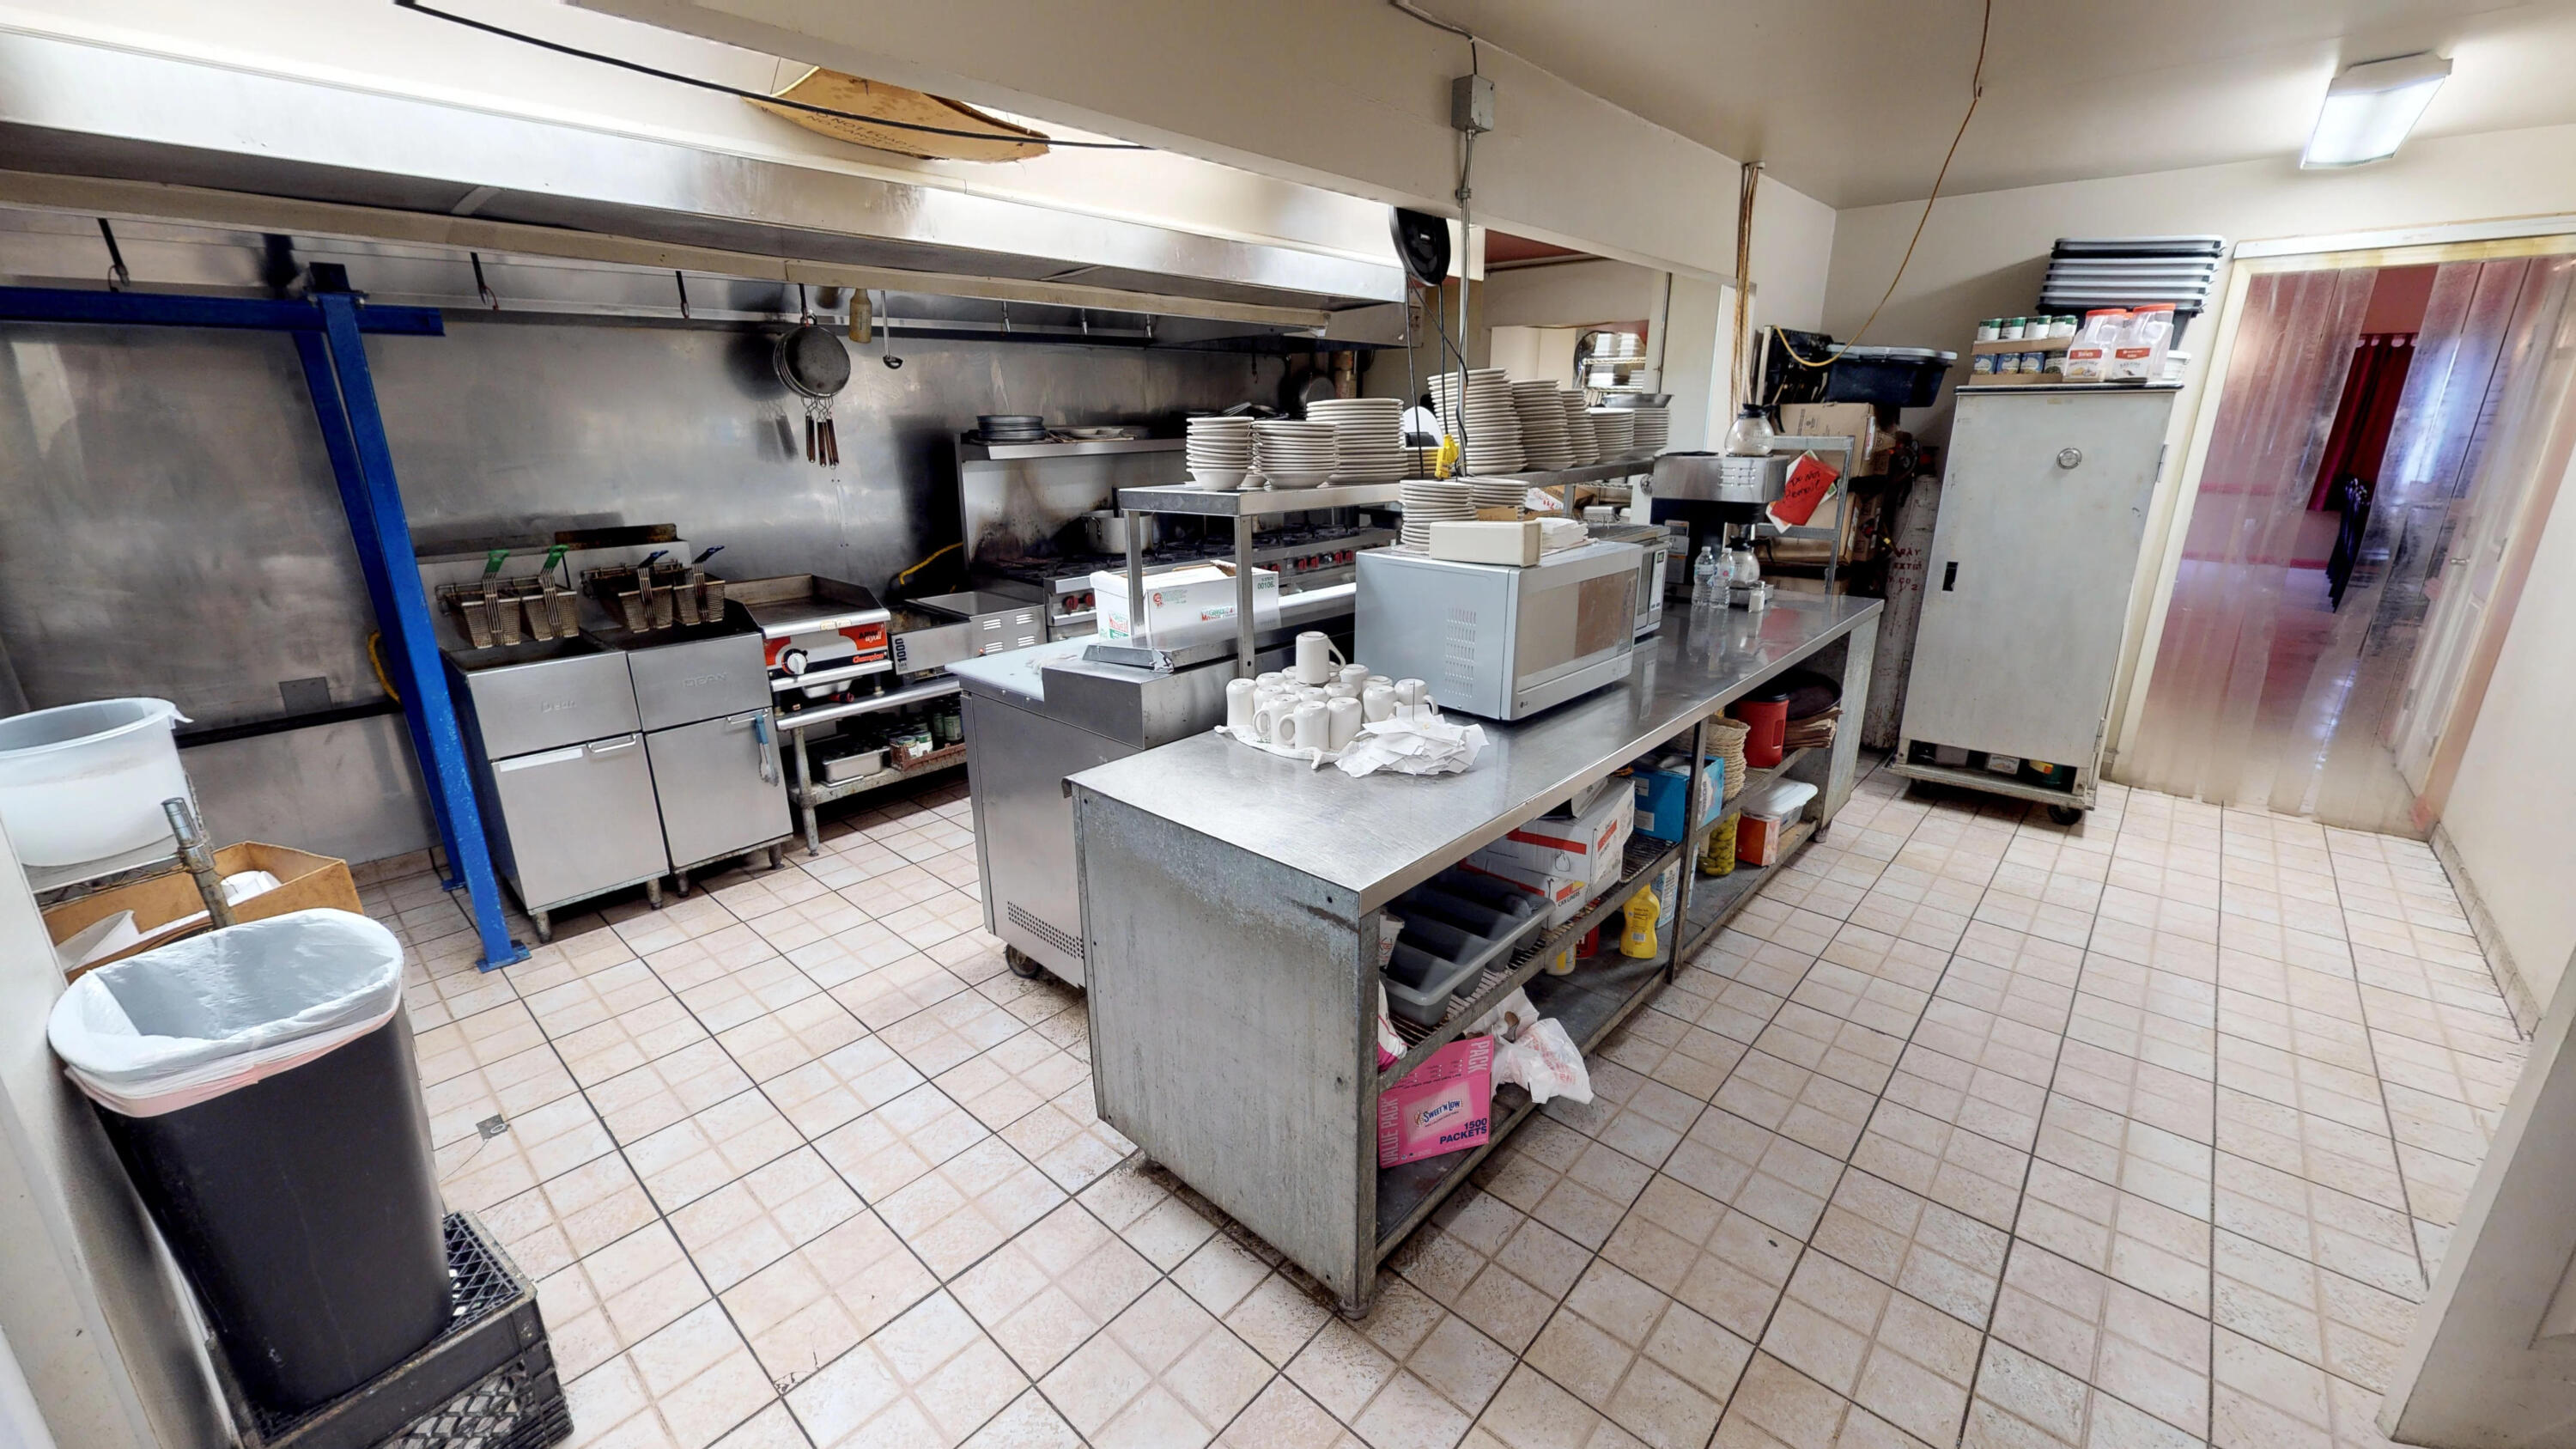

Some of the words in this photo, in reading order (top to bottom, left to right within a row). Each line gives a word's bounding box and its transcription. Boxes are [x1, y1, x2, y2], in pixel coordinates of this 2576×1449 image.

[895, 637, 907, 663] 1000
[1558, 898, 1567, 907] CAN
[1467, 1039, 1492, 1074] PACK
[1380, 1098, 1400, 1129] PACK
[1464, 1117, 1487, 1129] 1500
[1380, 1129, 1399, 1166] VALUE
[1439, 1125, 1487, 1145] PACKETS
